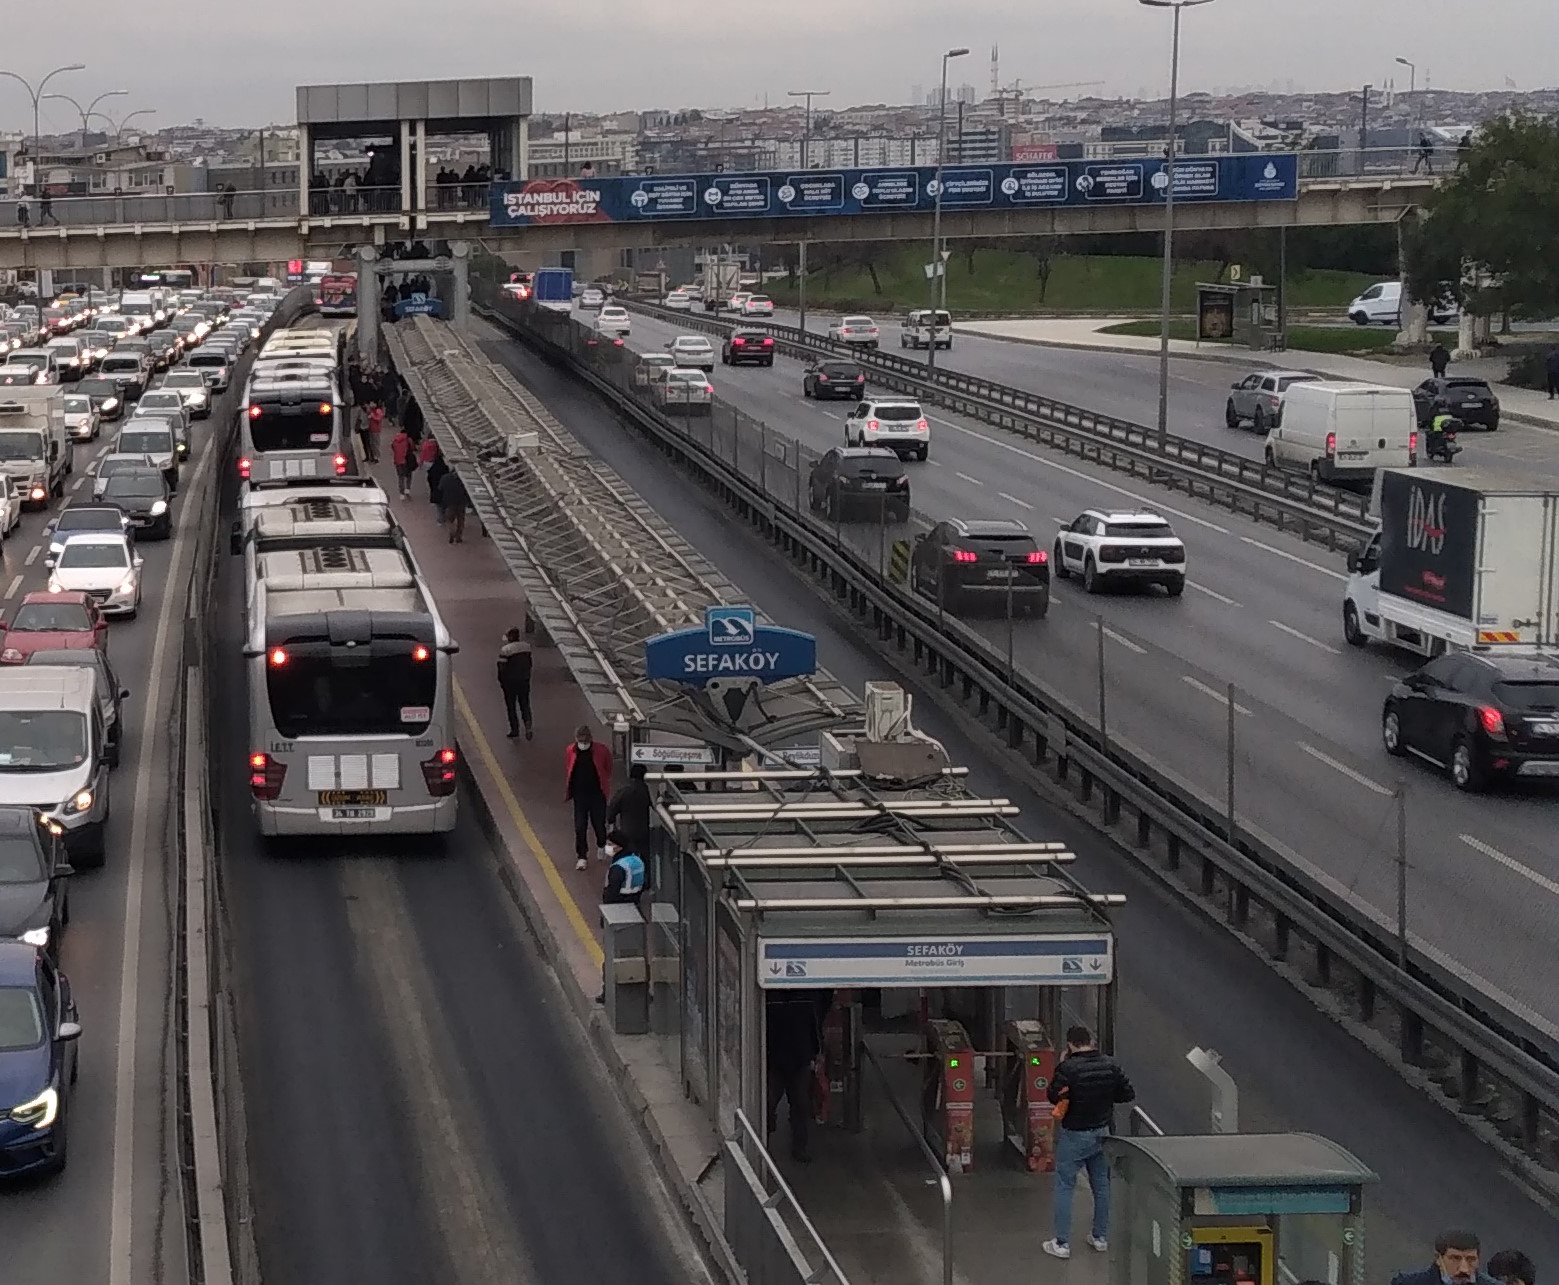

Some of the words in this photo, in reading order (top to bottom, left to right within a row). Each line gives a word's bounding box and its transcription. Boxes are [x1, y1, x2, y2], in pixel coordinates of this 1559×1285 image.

[503, 191, 570, 205] İSTANBUL
[573, 190, 600, 204] İÇİN
[508, 203, 596, 218] ÇALIŞIYORUZ
[684, 648, 780, 672] SEFAKÖY
[907, 944, 964, 956] SEFAKÖY
[946, 959, 965, 968] Giriş
